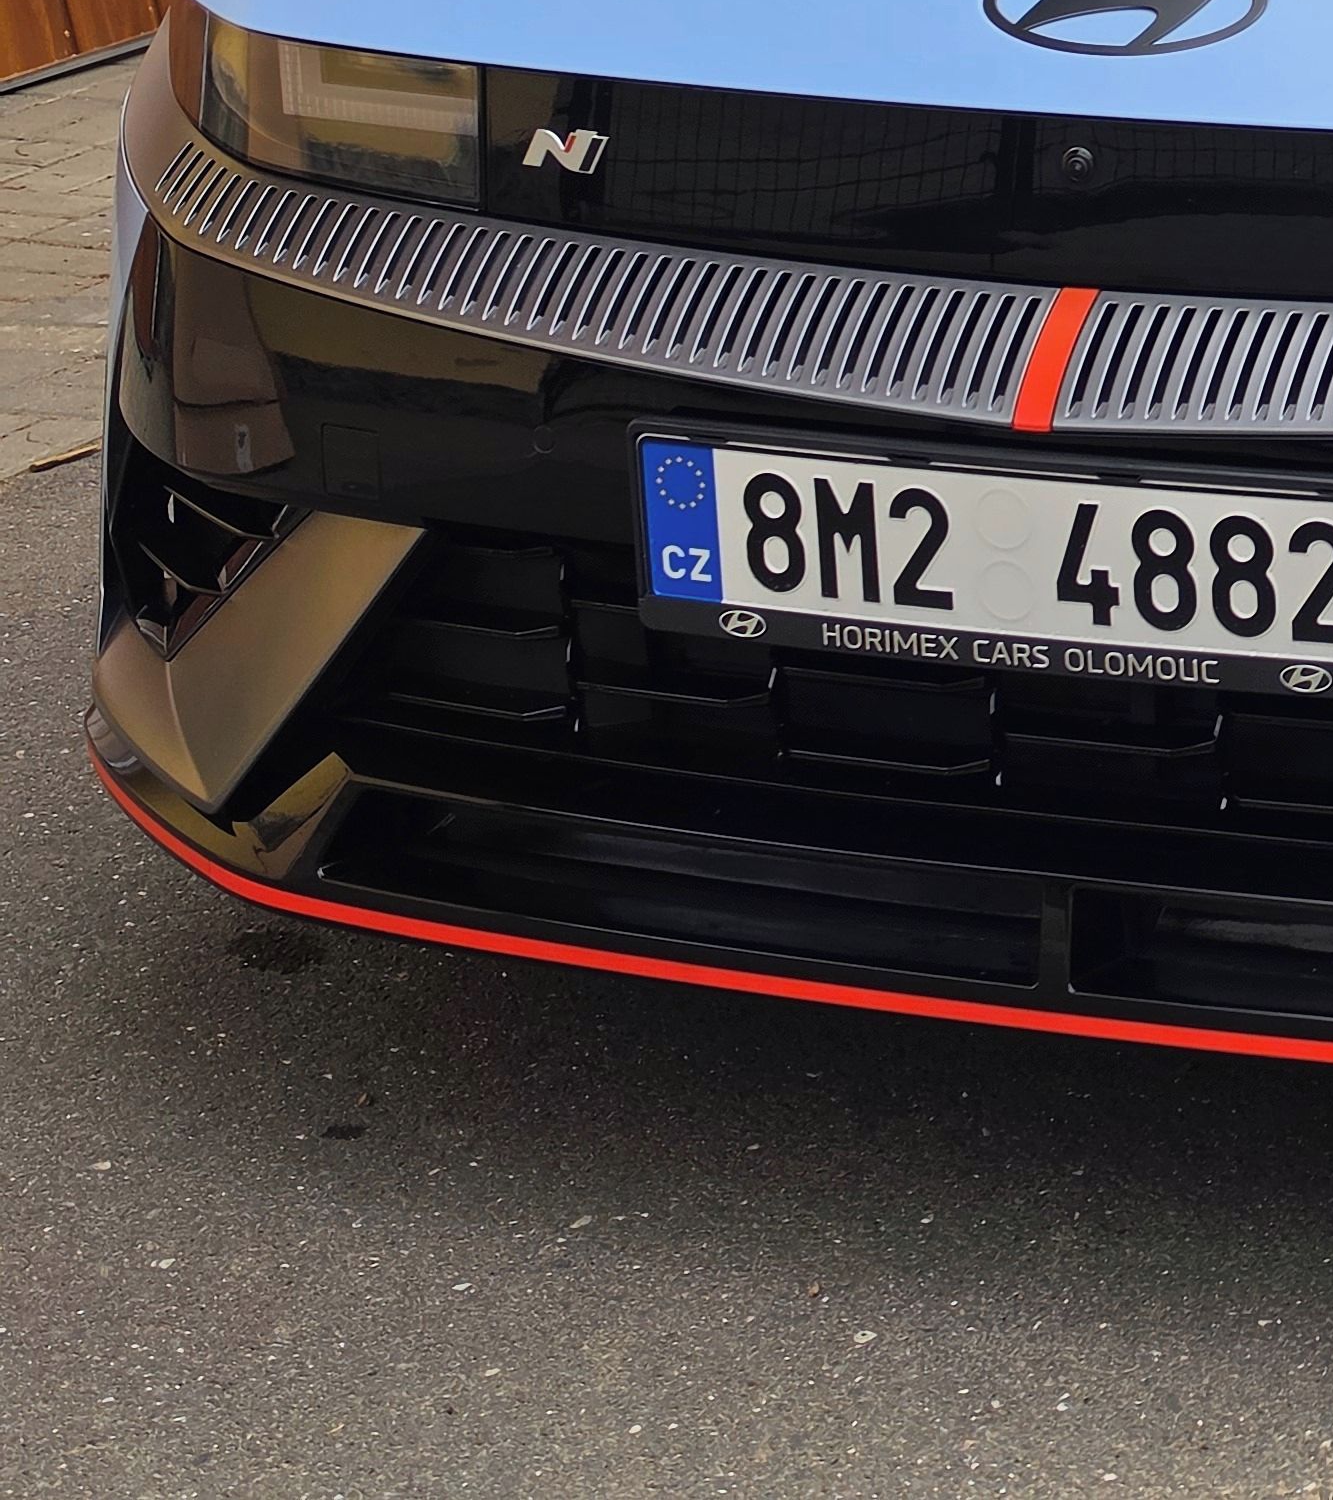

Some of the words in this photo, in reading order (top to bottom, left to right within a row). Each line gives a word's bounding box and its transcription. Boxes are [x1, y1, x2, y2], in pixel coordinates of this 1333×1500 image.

[661, 544, 713, 583] CZ
[742, 471, 954, 611] 8M2
[821, 622, 960, 661] HORIMEX
[971, 638, 1051, 670] CARS
[1063, 647, 1221, 686] OLOMOUC
